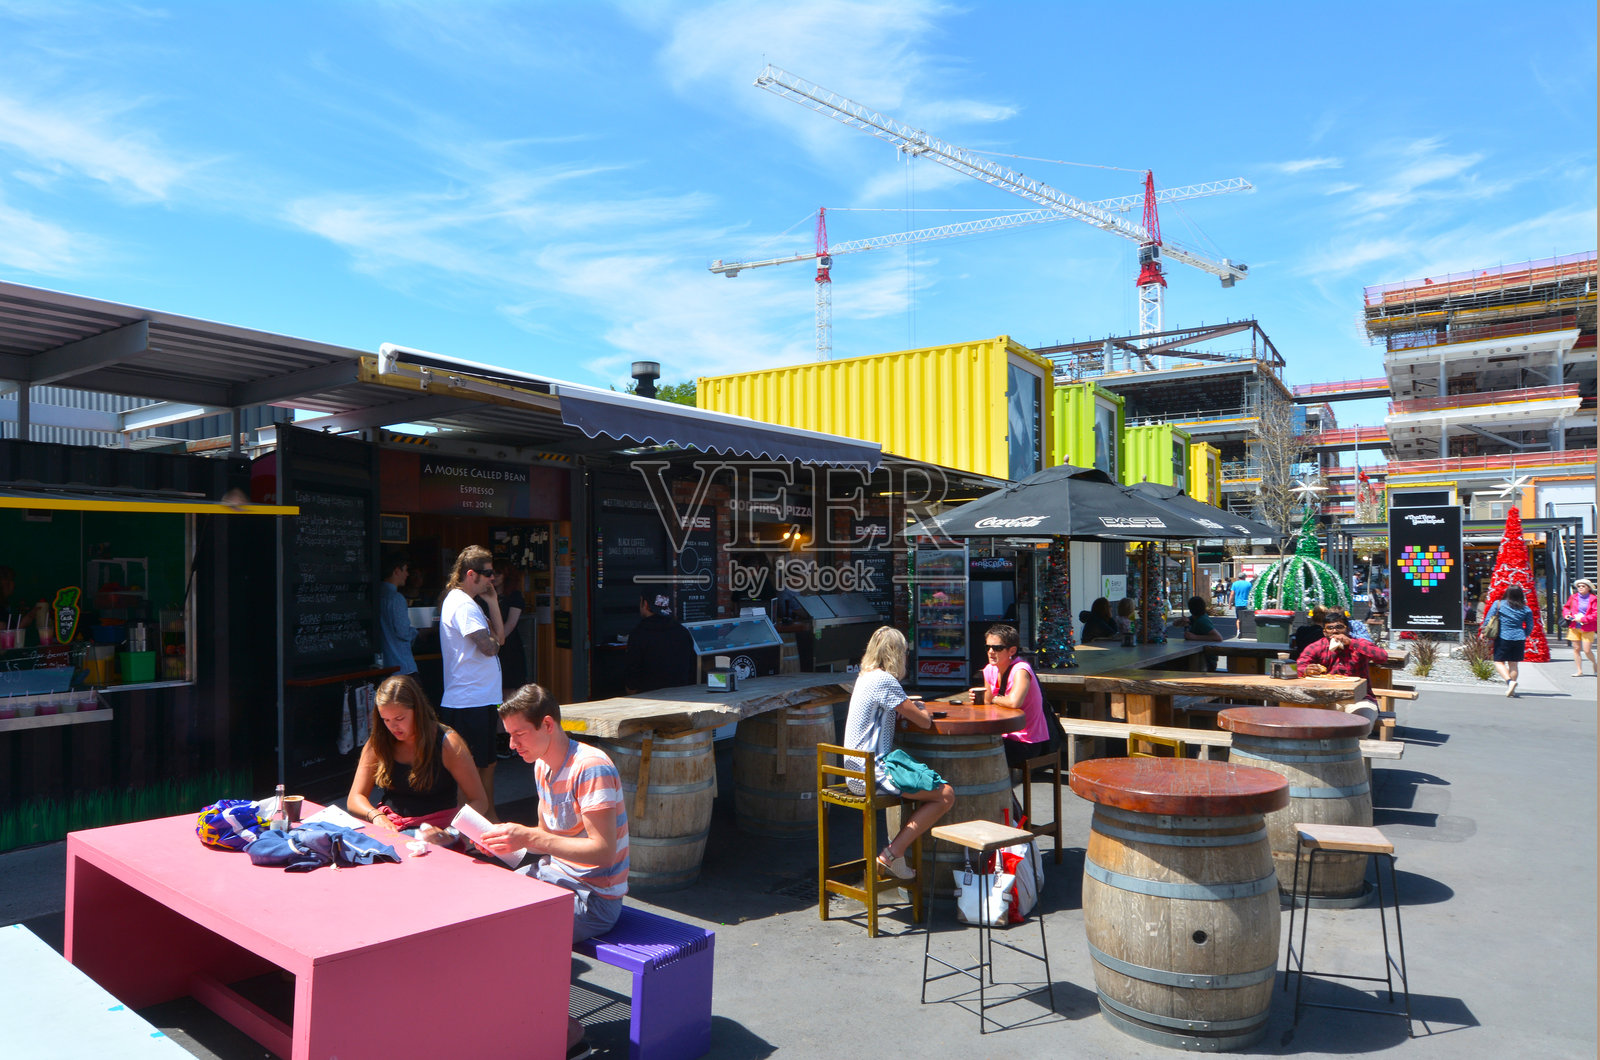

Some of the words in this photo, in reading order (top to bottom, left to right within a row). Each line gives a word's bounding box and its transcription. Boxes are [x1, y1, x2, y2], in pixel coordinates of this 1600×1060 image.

[424, 464, 432, 474] A
[435, 465, 468, 477] MOUSE
[470, 468, 502, 480] CALLED
[504, 471, 526, 482] BEAN
[460, 485, 494, 496] ESPRESSO
[475, 501, 492, 509] 2014
[729, 499, 782, 515] OODFIRED
[786, 505, 812, 518] PIZZA
[681, 516, 711, 528] BASE
[974, 515, 1051, 529] Coca-Cola
[855, 526, 887, 536] BASE
[921, 661, 950, 673] Coca-Cola
